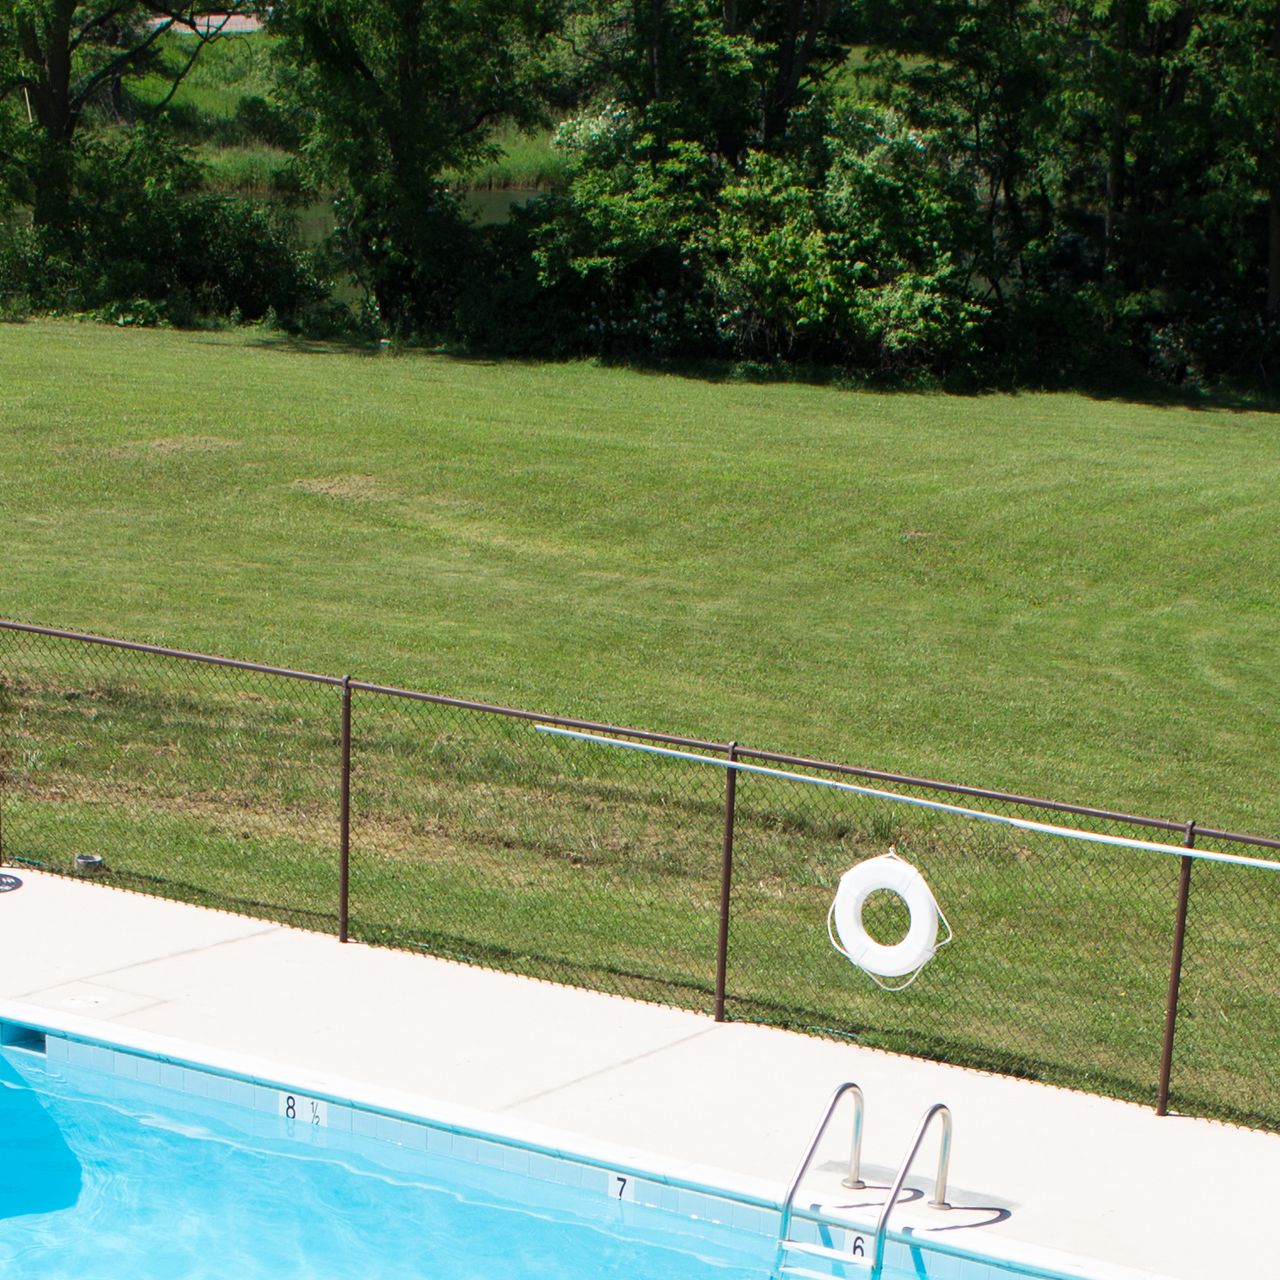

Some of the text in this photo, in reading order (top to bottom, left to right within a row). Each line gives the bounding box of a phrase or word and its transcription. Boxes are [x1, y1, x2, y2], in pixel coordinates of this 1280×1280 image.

[286, 1095, 297, 1120] 8
[616, 1177, 627, 1201] 7
[852, 1236, 866, 1258] 6
